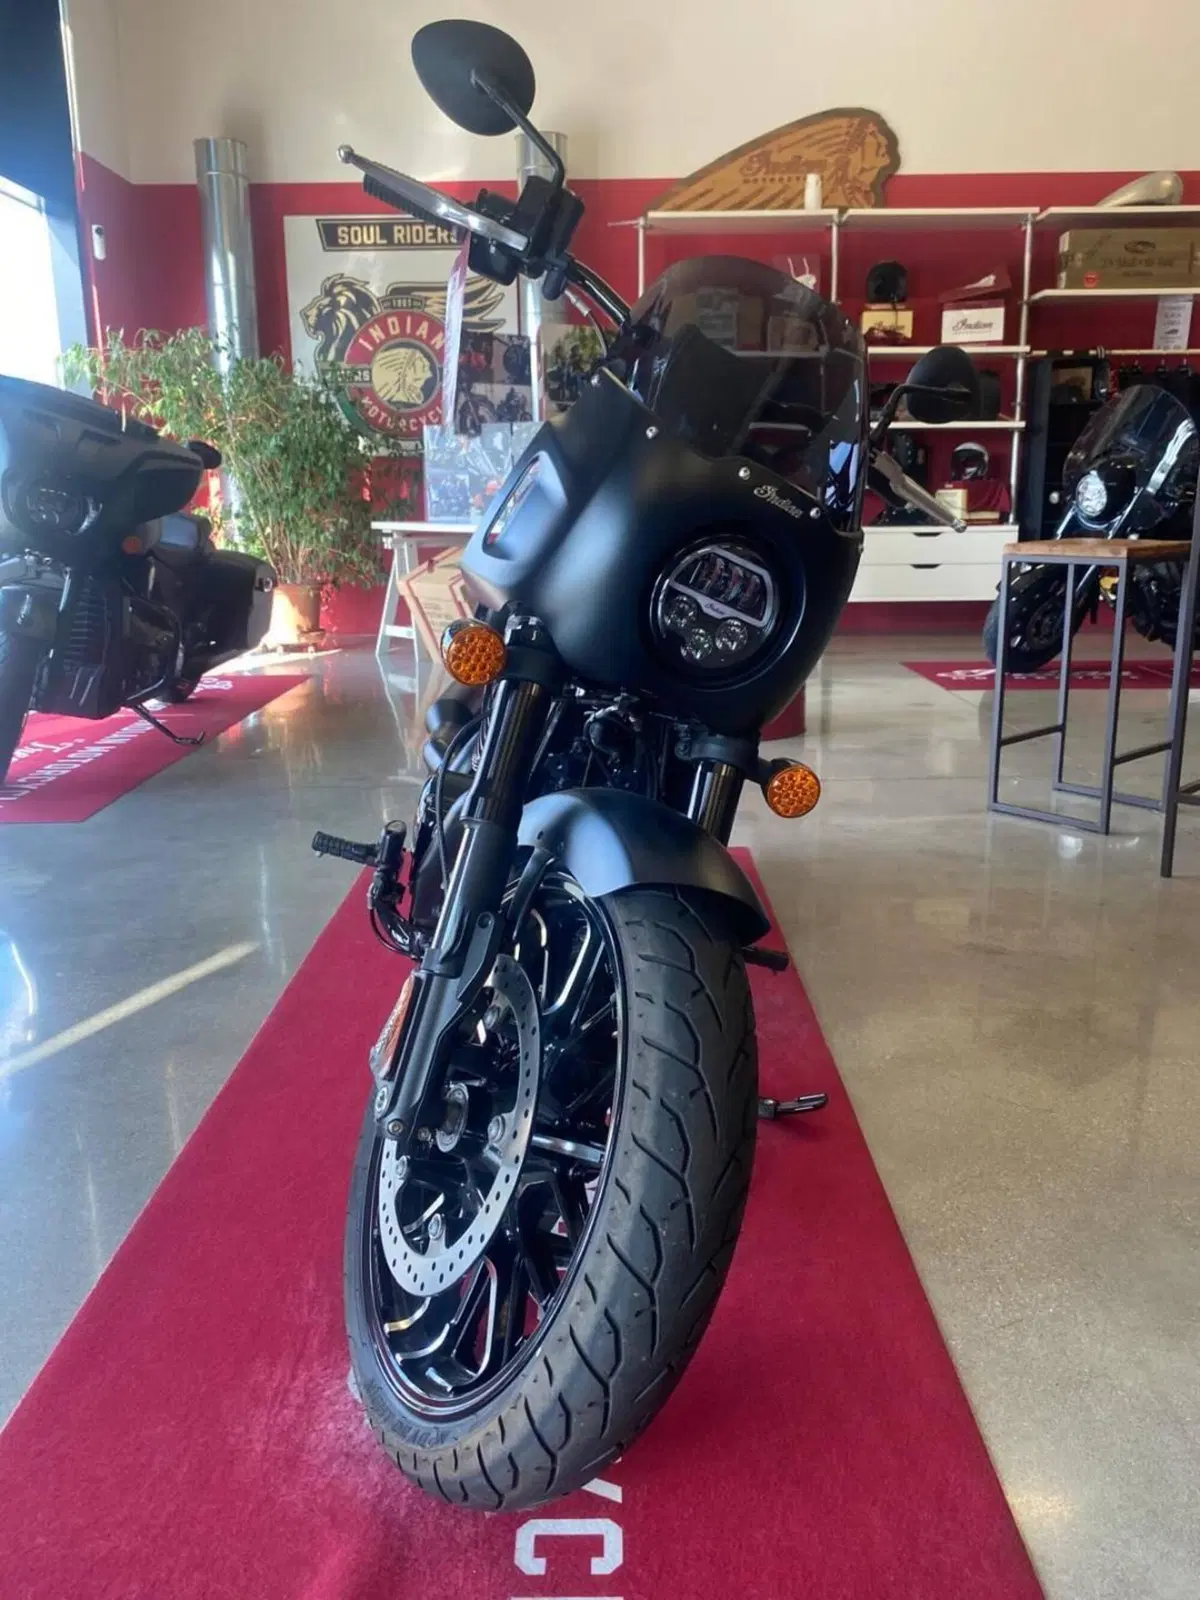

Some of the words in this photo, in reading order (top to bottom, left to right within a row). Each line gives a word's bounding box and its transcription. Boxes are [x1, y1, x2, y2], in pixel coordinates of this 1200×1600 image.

[337, 225, 388, 245] SOUL
[358, 315, 445, 351] INDIAN
[753, 485, 803, 519] Indian
